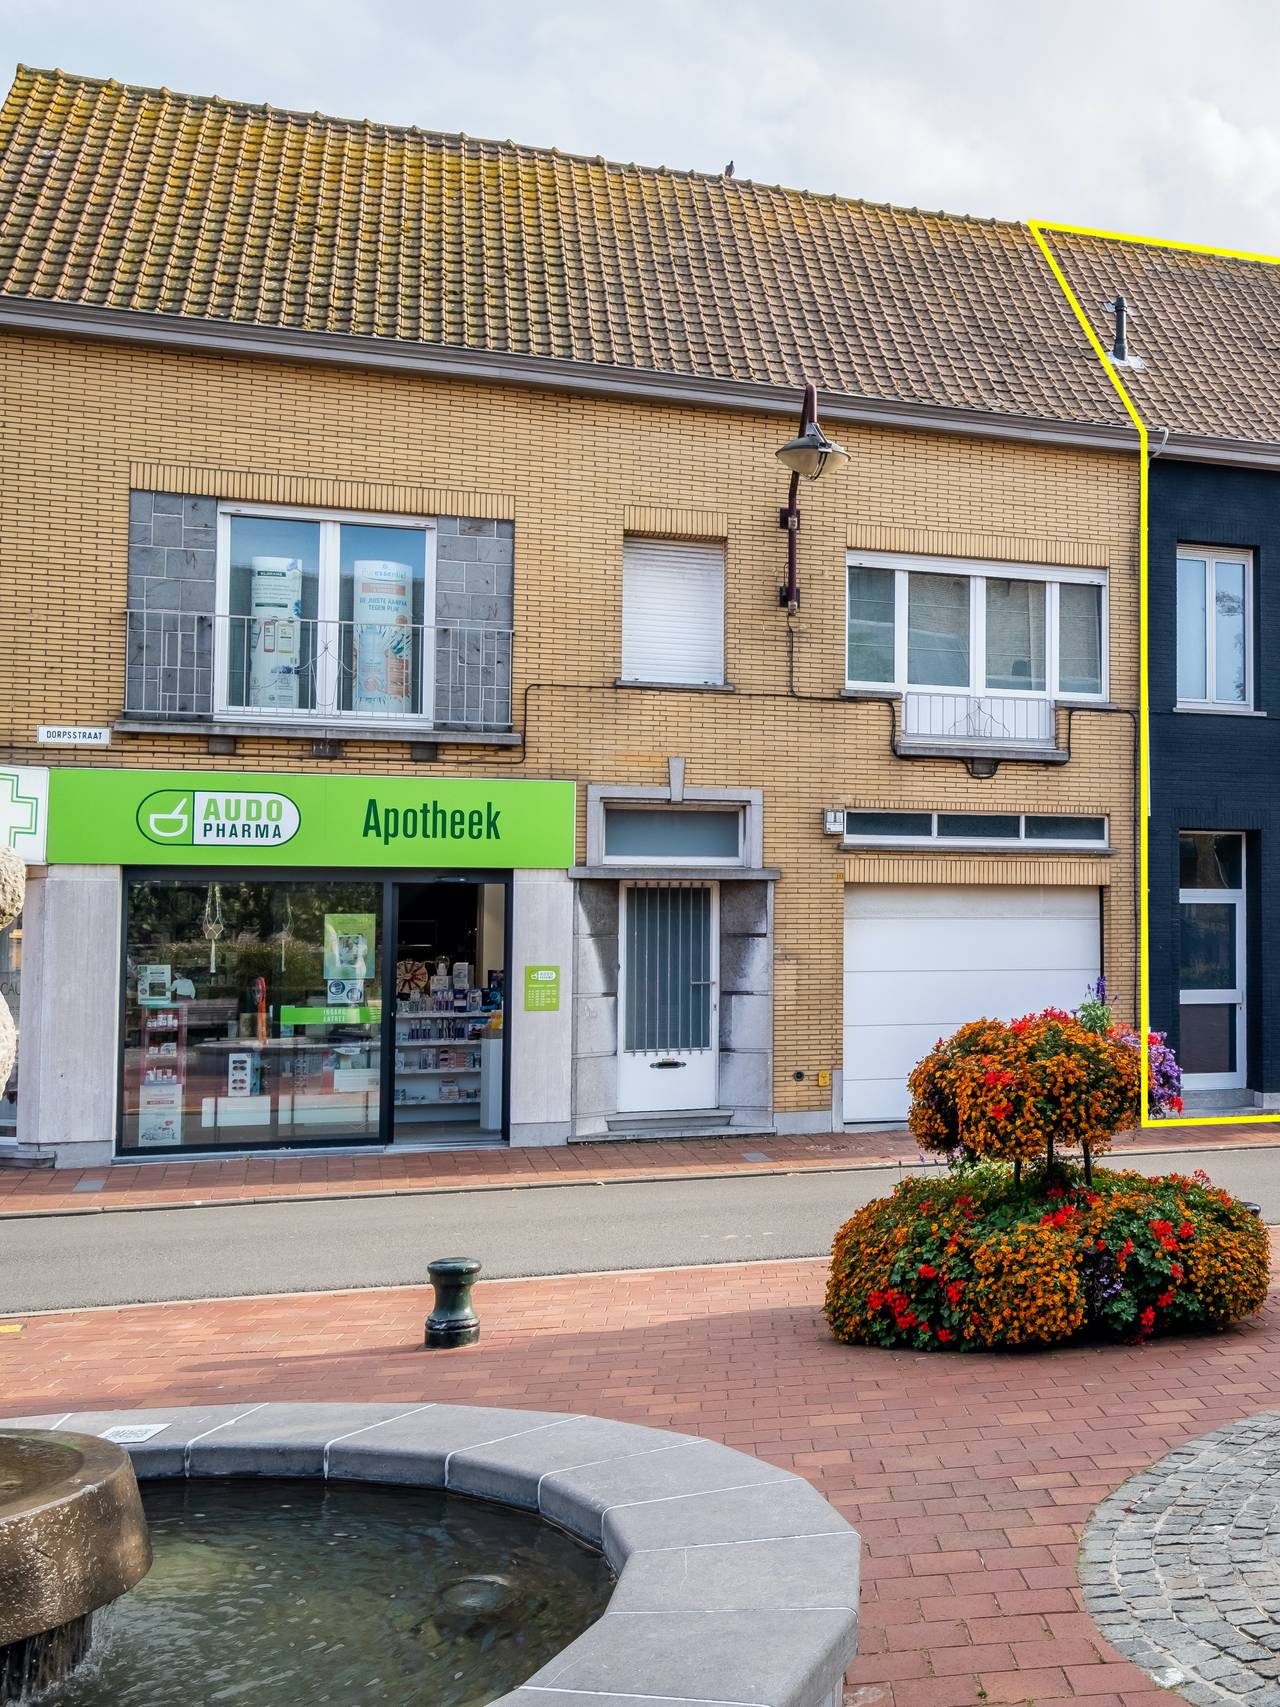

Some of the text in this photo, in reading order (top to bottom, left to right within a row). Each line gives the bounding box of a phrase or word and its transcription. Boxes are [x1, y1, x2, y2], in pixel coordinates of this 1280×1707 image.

[46, 730, 103, 740] DORPSSTRAAT
[203, 798, 283, 822] AUDO
[203, 823, 282, 839] PHARMA
[362, 798, 501, 846] Apotheek
